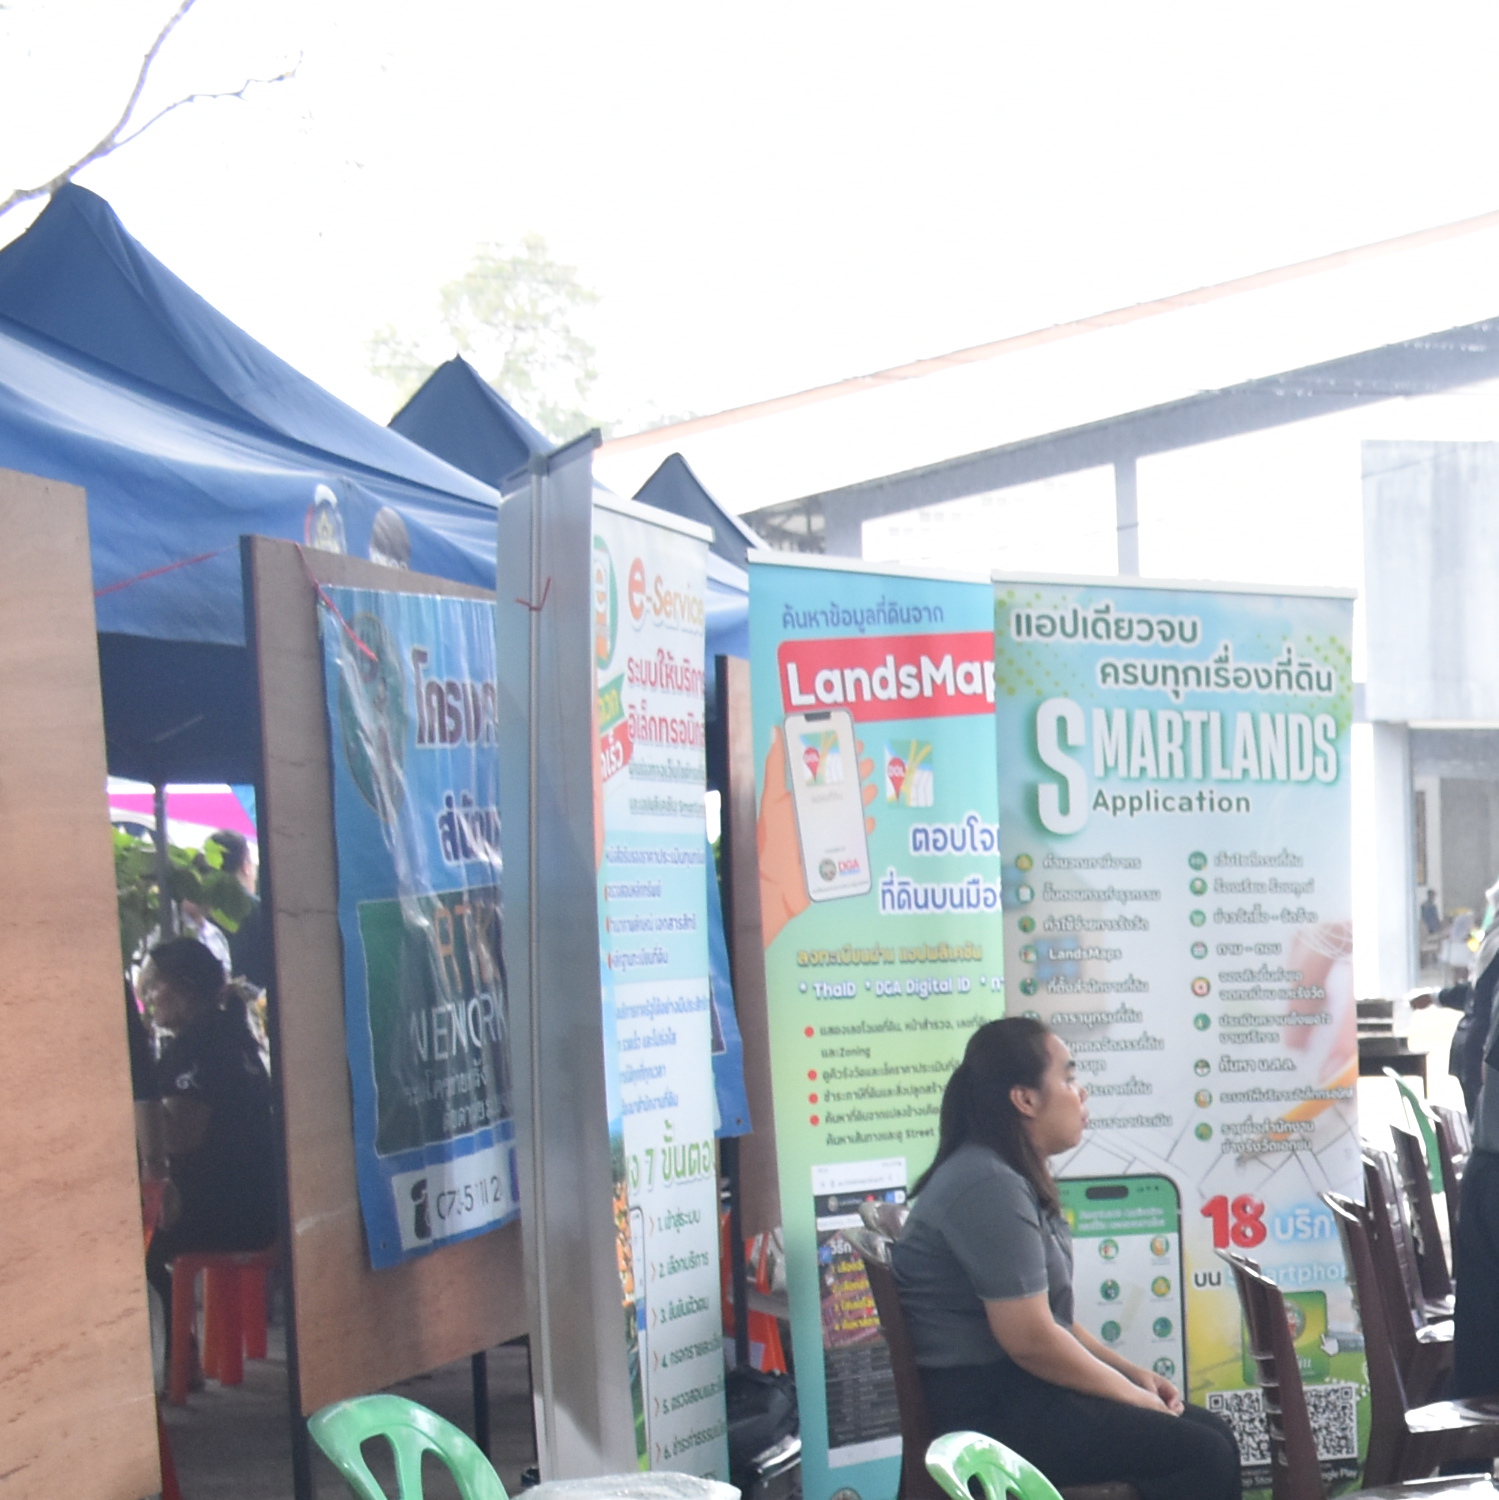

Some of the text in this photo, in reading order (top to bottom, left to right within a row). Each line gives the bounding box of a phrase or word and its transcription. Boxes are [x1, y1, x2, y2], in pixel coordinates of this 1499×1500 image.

[782, 595, 945, 634] ค้นหาข้อมูลที่ดินจาก
[1014, 603, 1198, 643] แอปเดียวจบ
[1100, 645, 1333, 699] ครบทุกเรื่องที่ดิน
[1036, 697, 1338, 835] SMARTLANDS
[1092, 788, 1252, 817] Application
[912, 815, 1000, 853] ตอบโจ
[881, 870, 1001, 911] ที่ดินบนมือ
[906, 977, 953, 999] Digital
[661, 1118, 714, 1182] ขั้นตอ
[1201, 1194, 1267, 1249] 18
[1194, 1271, 1221, 1288] บน
